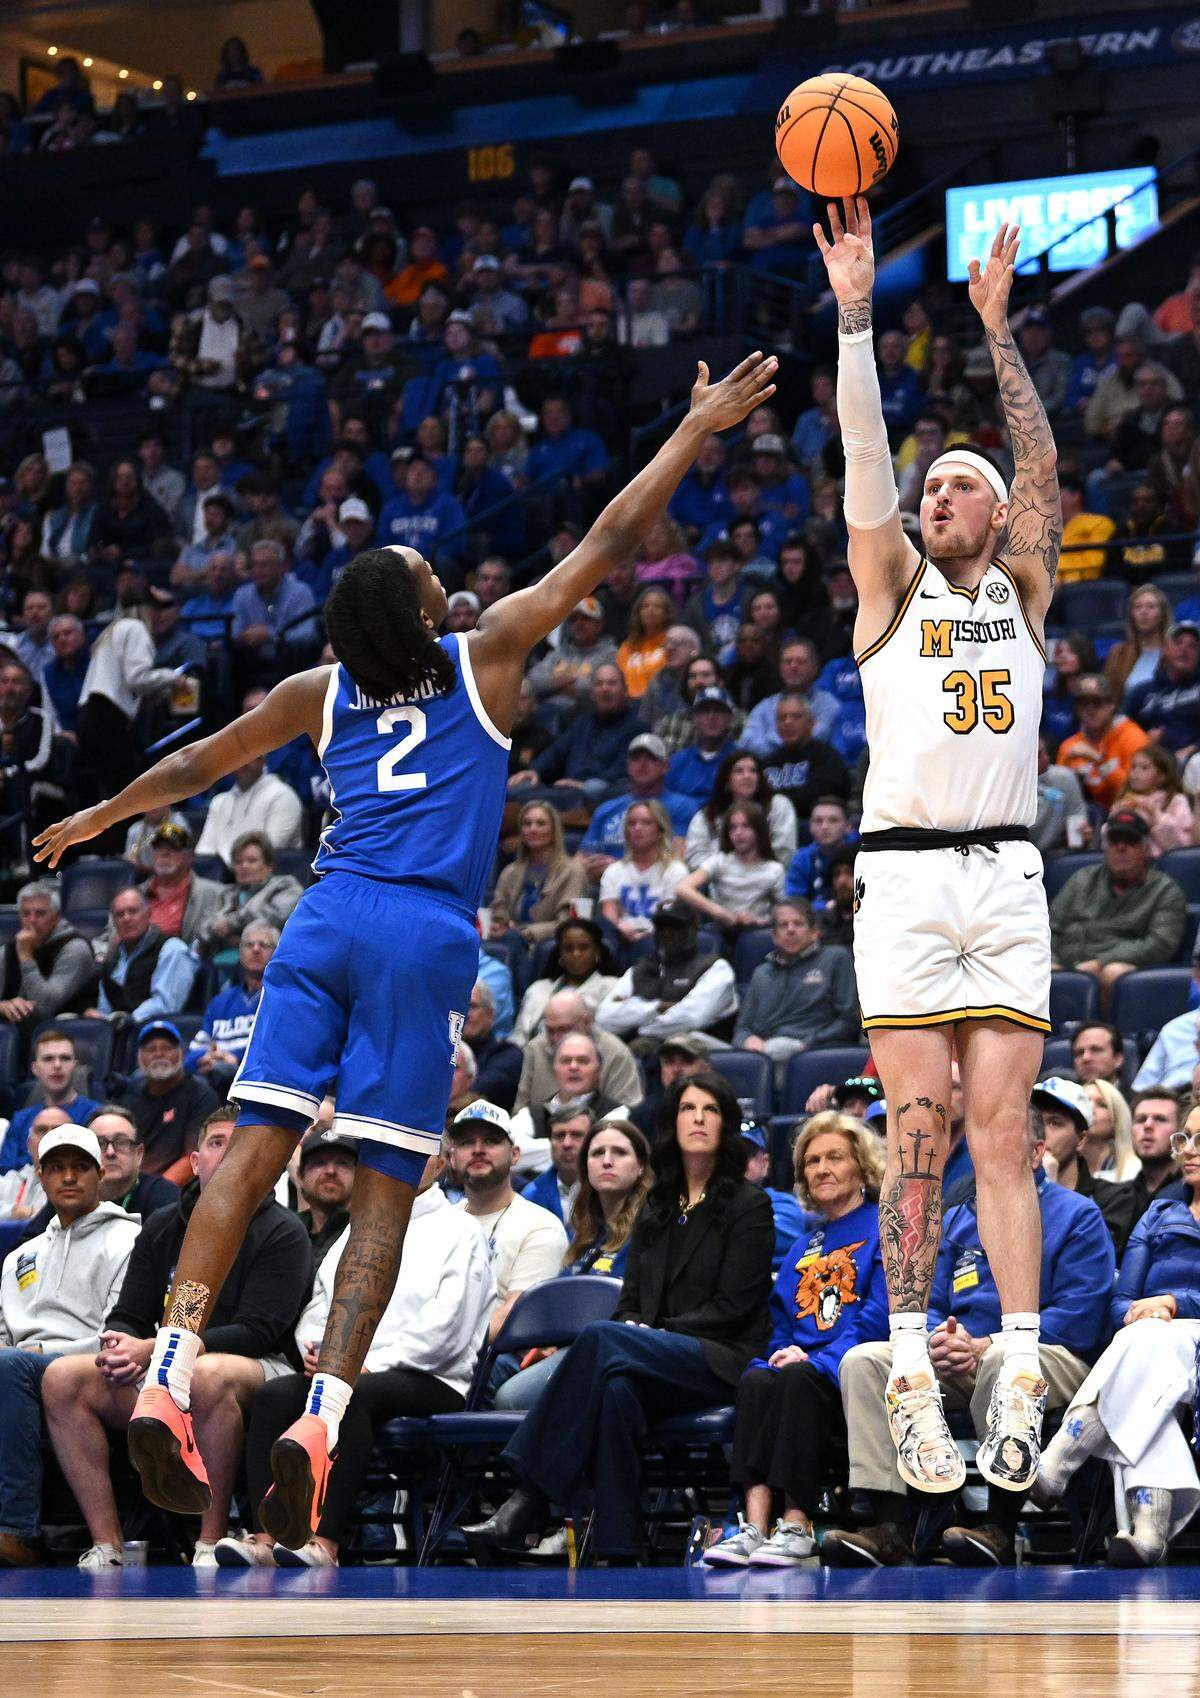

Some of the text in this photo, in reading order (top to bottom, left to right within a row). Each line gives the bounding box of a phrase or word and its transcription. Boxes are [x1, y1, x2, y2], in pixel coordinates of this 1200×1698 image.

[964, 195, 1042, 232] LIVE
[986, 582, 1010, 604] SEC
[920, 617, 1017, 657] MISSOURI
[942, 669, 1015, 734] 35
[376, 705, 427, 792] 2
